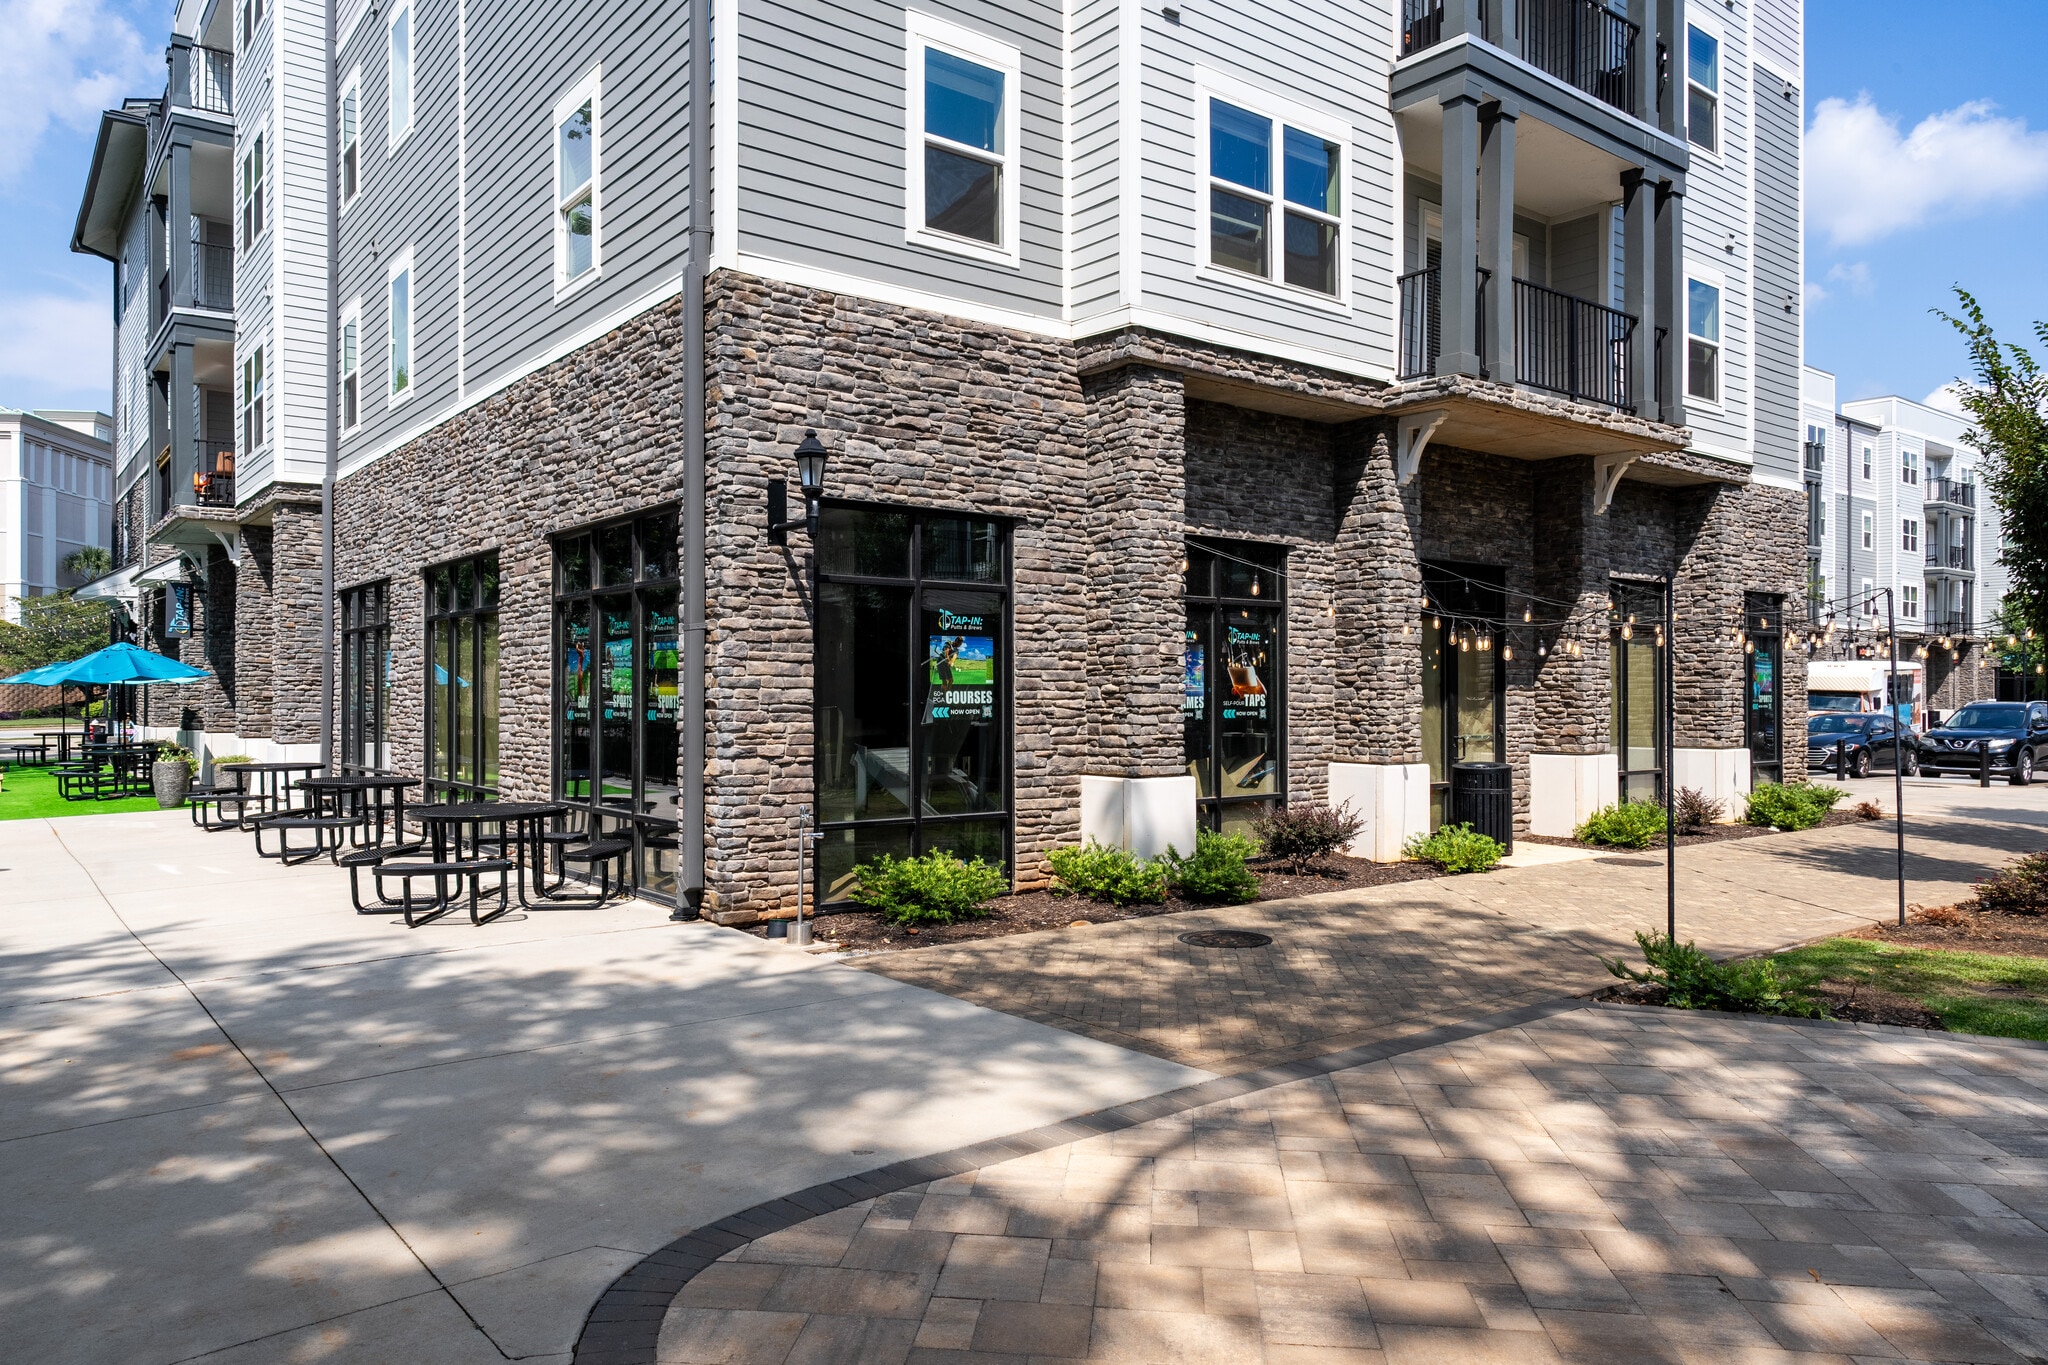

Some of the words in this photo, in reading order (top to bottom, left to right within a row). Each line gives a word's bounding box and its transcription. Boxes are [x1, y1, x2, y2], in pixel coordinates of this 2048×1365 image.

[951, 616, 983, 625] TAP-IN:
[613, 695, 632, 708] SPORTS
[945, 691, 993, 704] COURSES
[1244, 694, 1266, 707] TAPS
